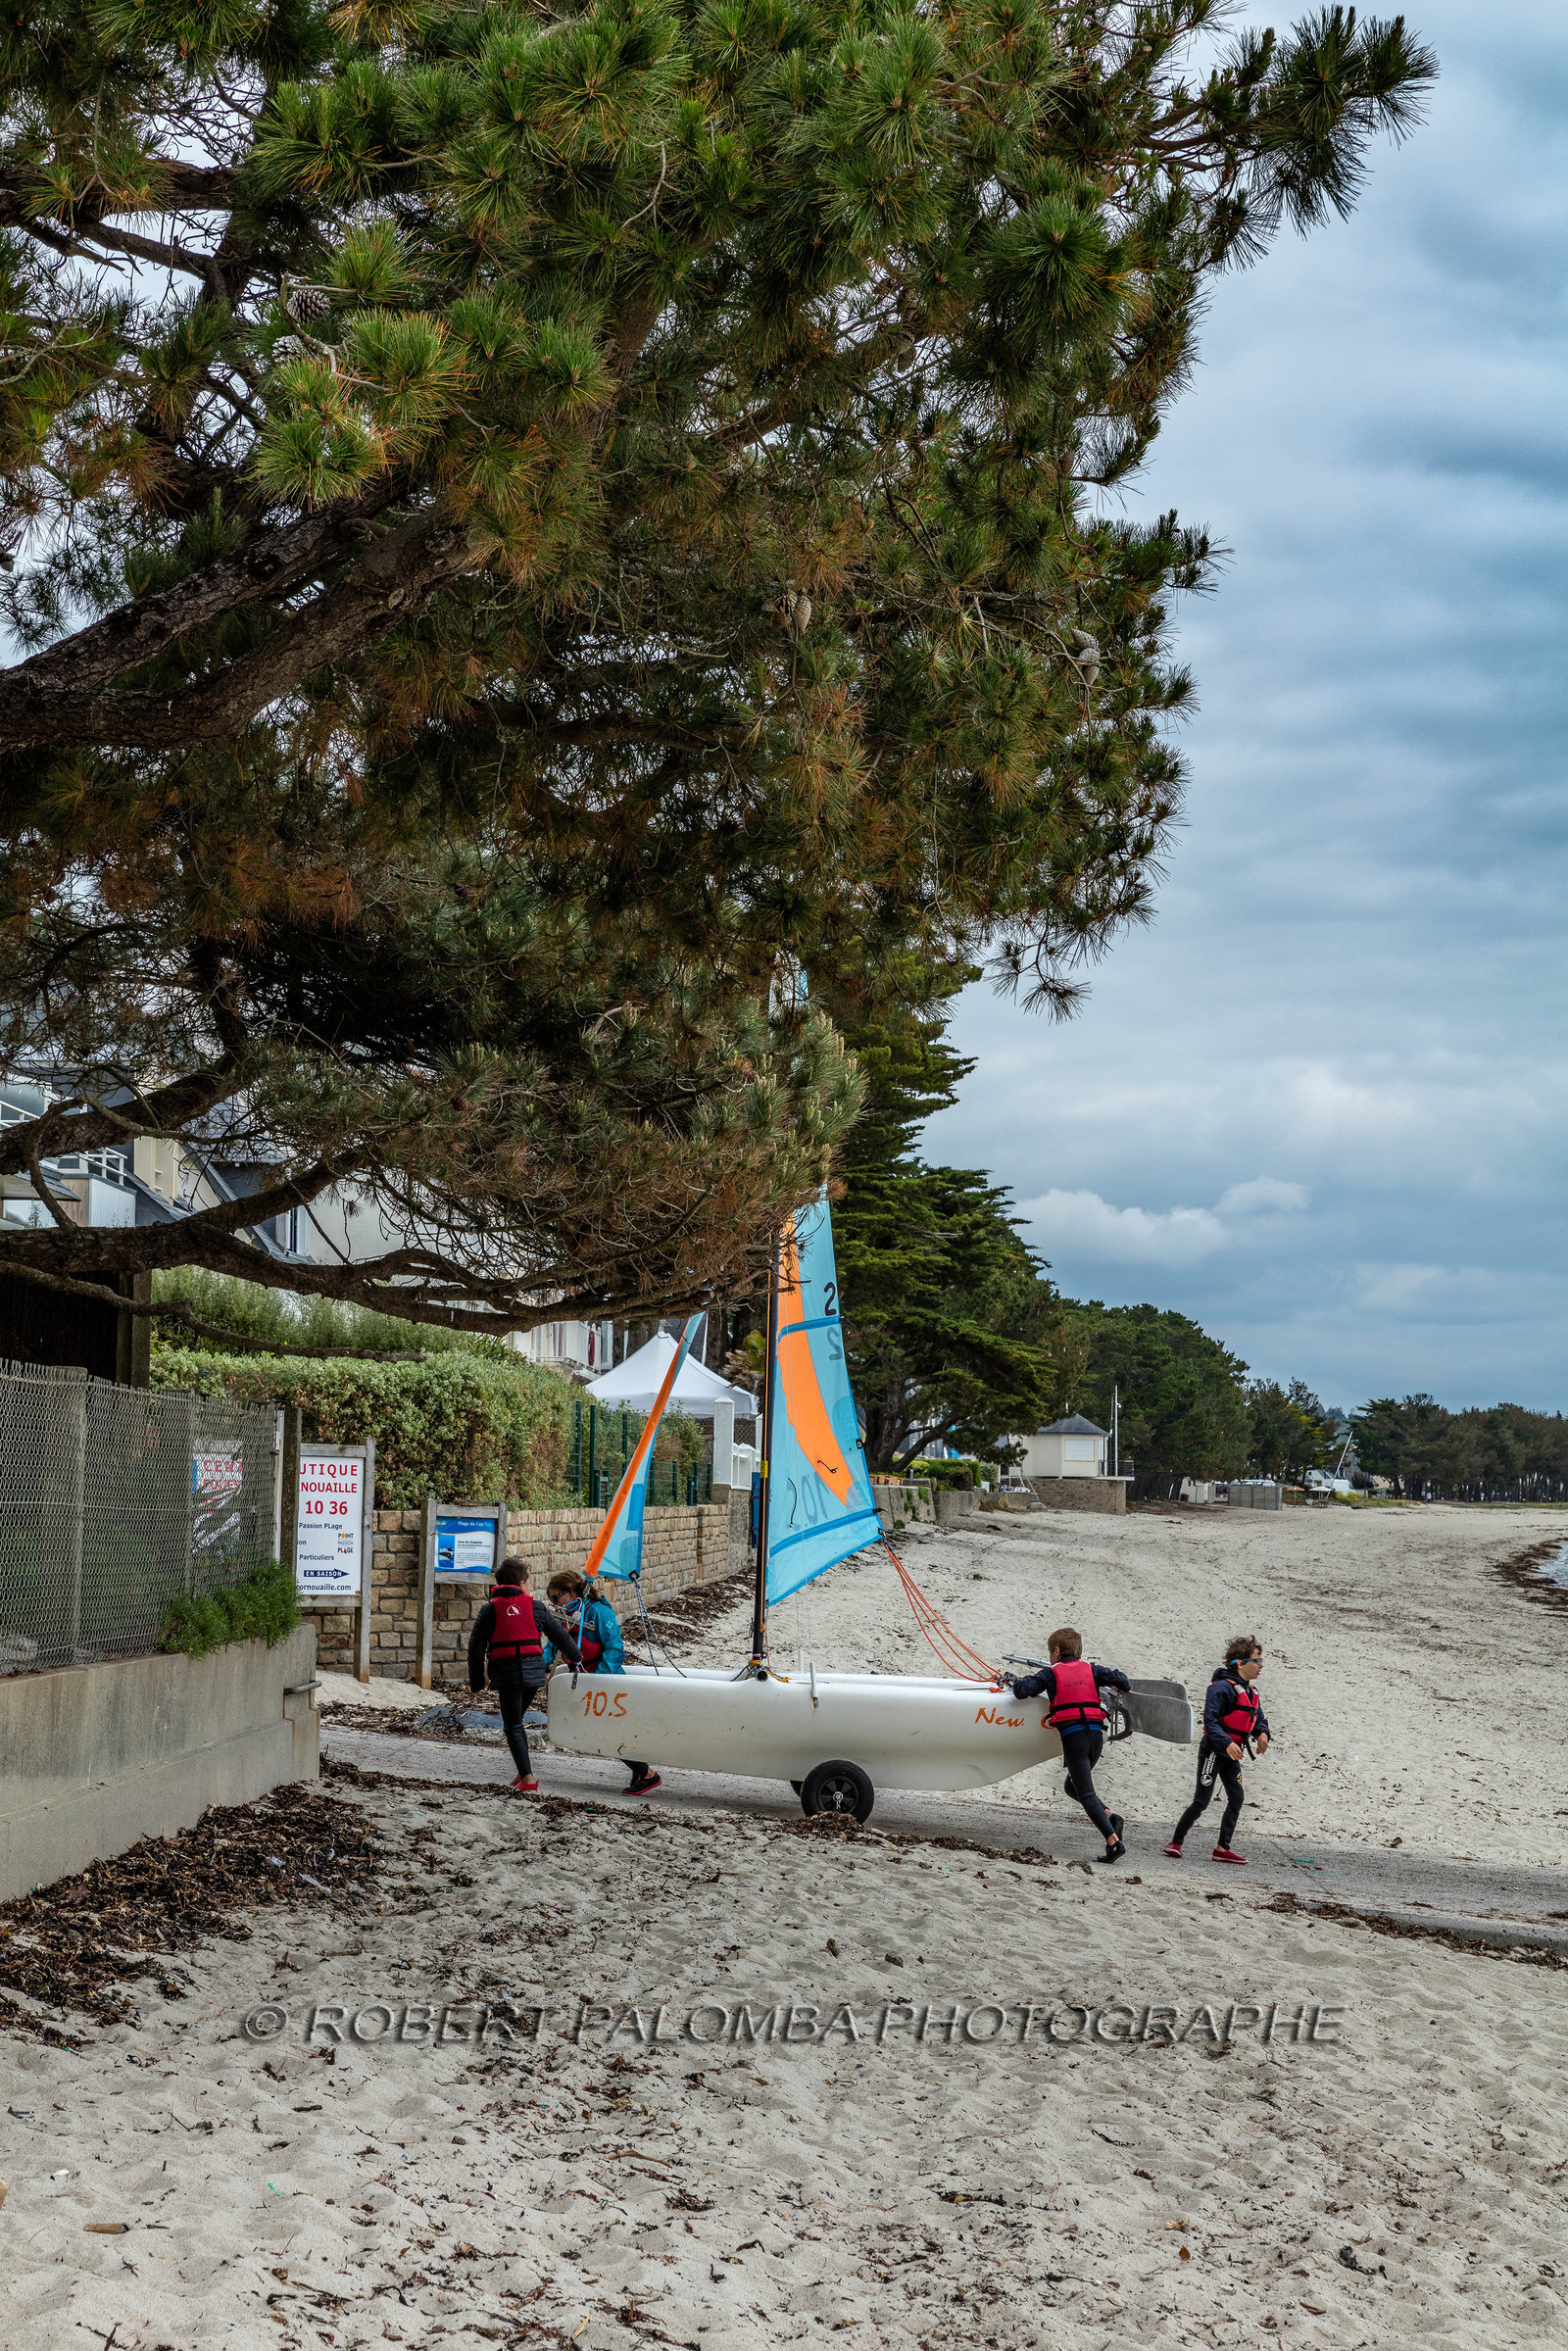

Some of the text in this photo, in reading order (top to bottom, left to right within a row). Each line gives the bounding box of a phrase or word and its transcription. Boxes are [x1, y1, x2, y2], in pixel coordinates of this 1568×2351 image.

[824, 1281, 837, 1316] 2
[299, 1482, 358, 1494] NOUAILLE
[305, 1500, 348, 1515] 10 36
[580, 1690, 628, 1718] 10.5
[974, 1706, 1024, 1728] New
